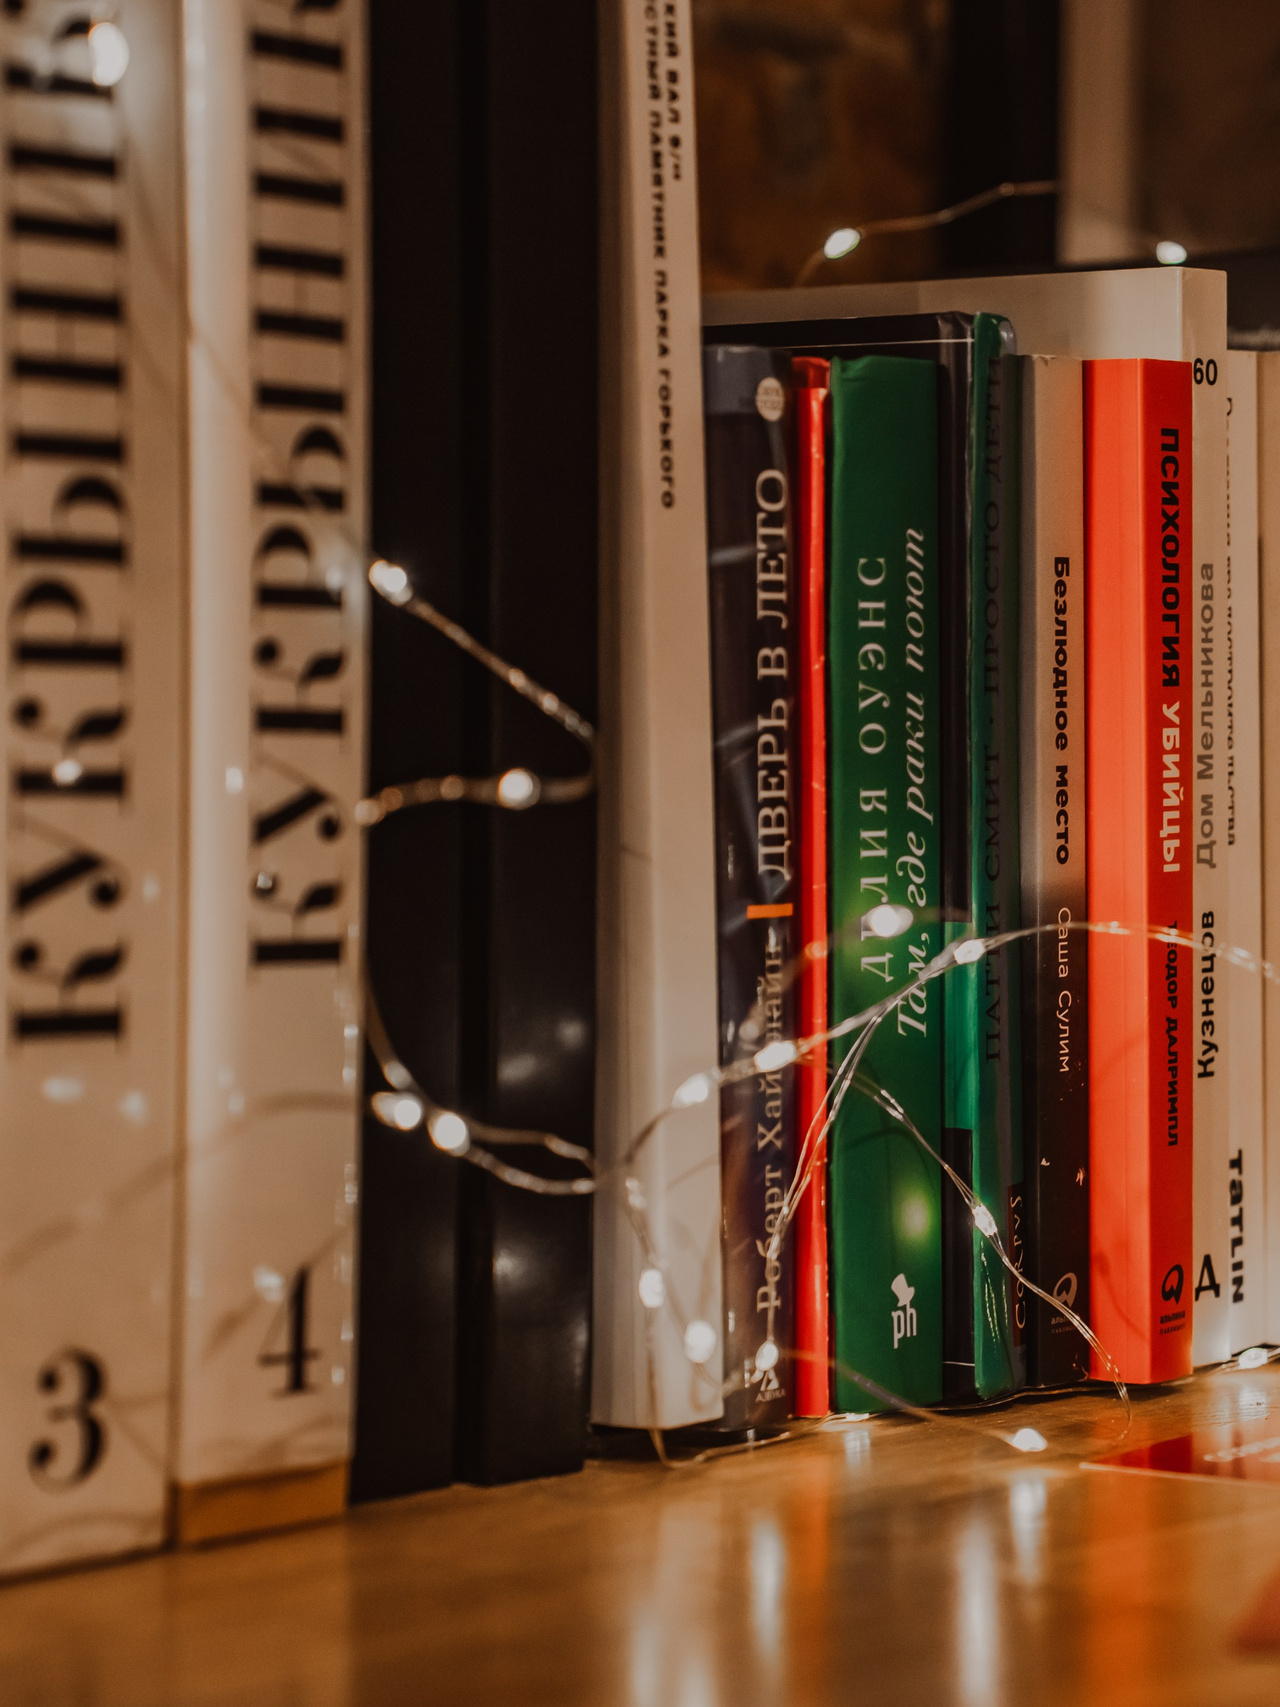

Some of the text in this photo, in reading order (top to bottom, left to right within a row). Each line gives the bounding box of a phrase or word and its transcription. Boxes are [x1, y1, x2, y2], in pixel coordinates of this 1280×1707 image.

[666, 69, 681, 124] ВАЛ
[650, 110, 666, 258] ПАМЯТНИК
[655, 269, 671, 357] ПАРКА
[1193, 358, 1218, 386] 60
[658, 368, 675, 510] ГОРЬКОГО
[756, 469, 791, 881] ДВЕРЬ В ЛЕТО
[857, 557, 890, 755] ОУЭНС
[984, 502, 1000, 696] ПРОСТО
[1160, 428, 1184, 872] ПСИХОЛОГИЯ УБИЙЦЫ
[896, 528, 934, 1037] Там, где раки поют
[1053, 556, 1070, 866] Безлюдное место
[1196, 562, 1217, 869] Дом Мельникова
[984, 746, 1000, 882] СМИТ
[984, 902, 1000, 1065] ПАТТИ
[1057, 907, 1071, 1073] Саша Сулим
[1197, 910, 1218, 1078] Кузнецов
[756, 946, 783, 1313] Роберт Хайлайн
[1165, 1016, 1179, 1146] ДАЛРИМПЛ
[257, 1266, 323, 1396] 4
[28, 1347, 107, 1491] 3
